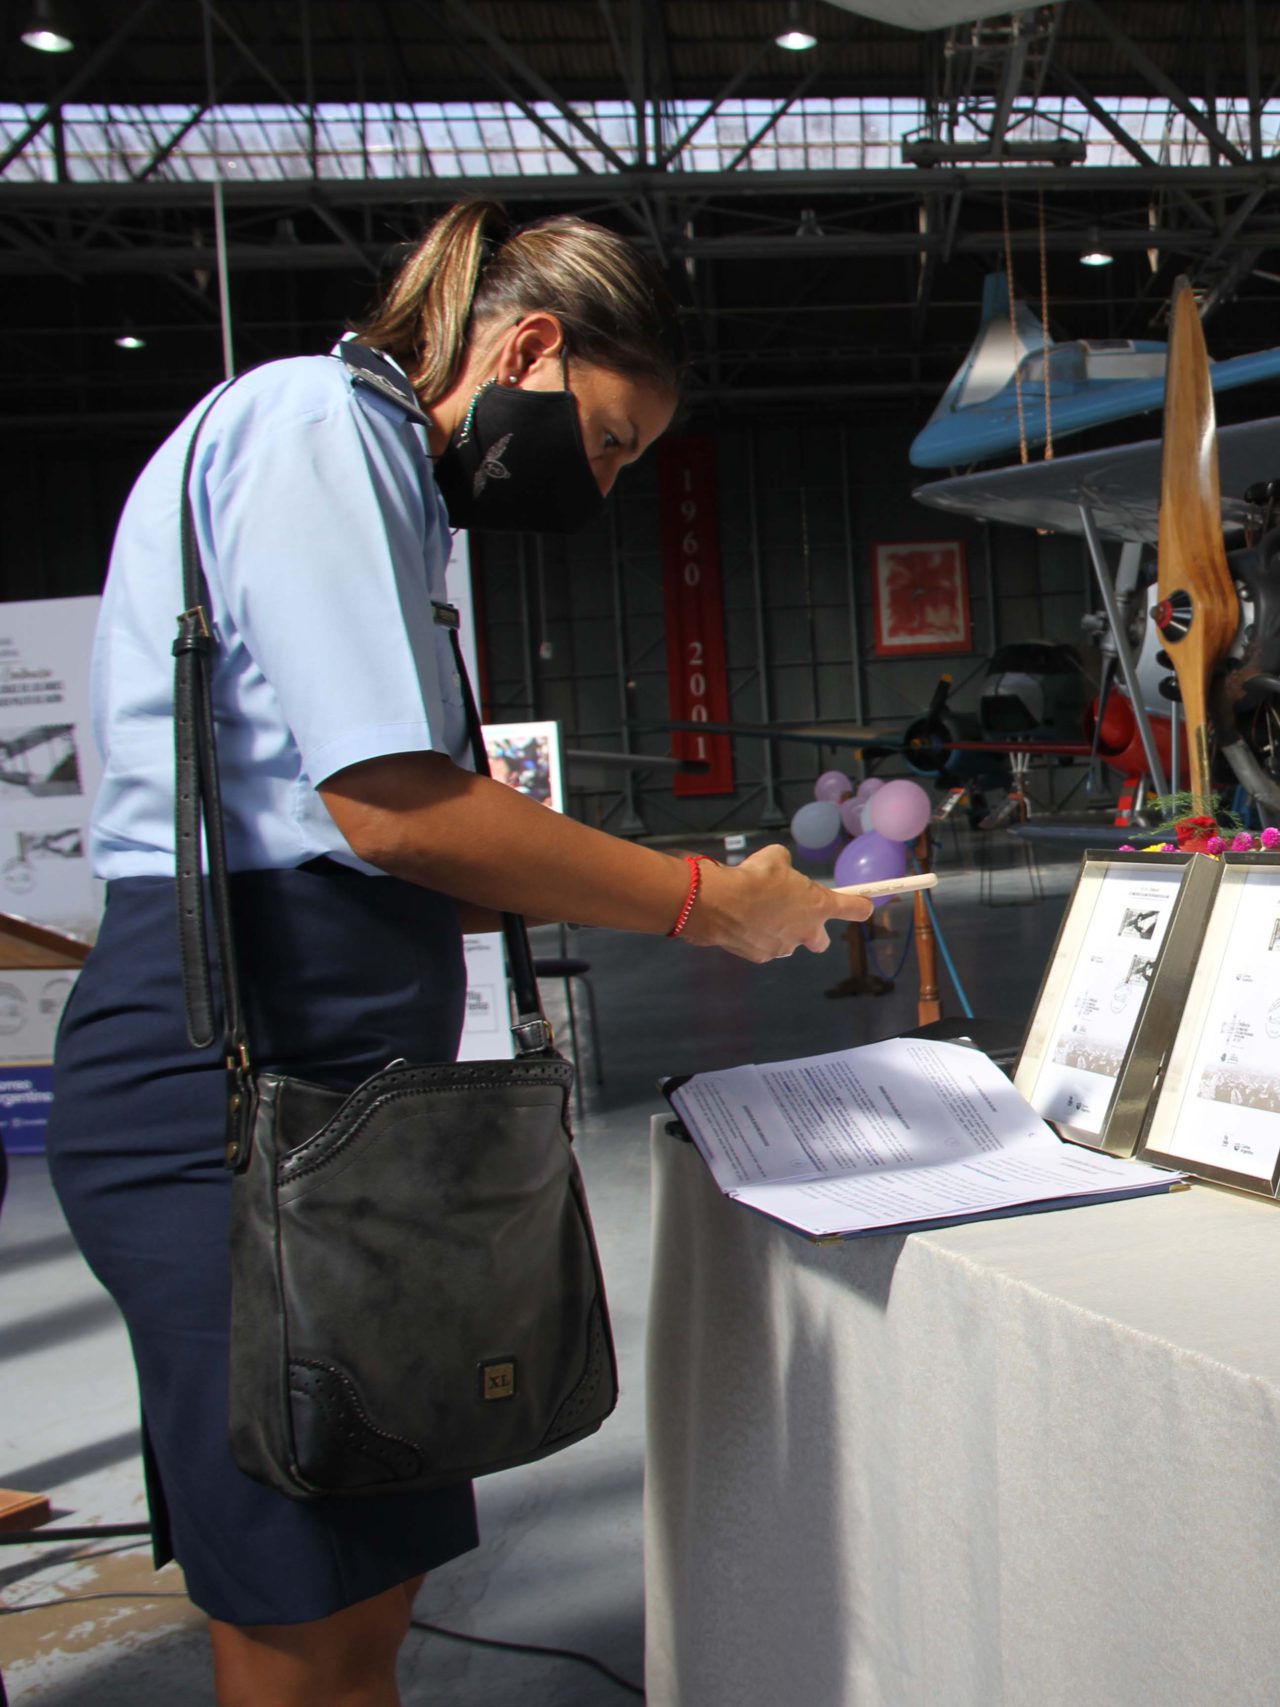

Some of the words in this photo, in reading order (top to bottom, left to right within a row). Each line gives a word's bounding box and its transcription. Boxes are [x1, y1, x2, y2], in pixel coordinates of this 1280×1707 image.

[681, 469, 701, 587] 1960
[689, 642, 708, 760] 2001
[489, 1375, 511, 1389] XL
